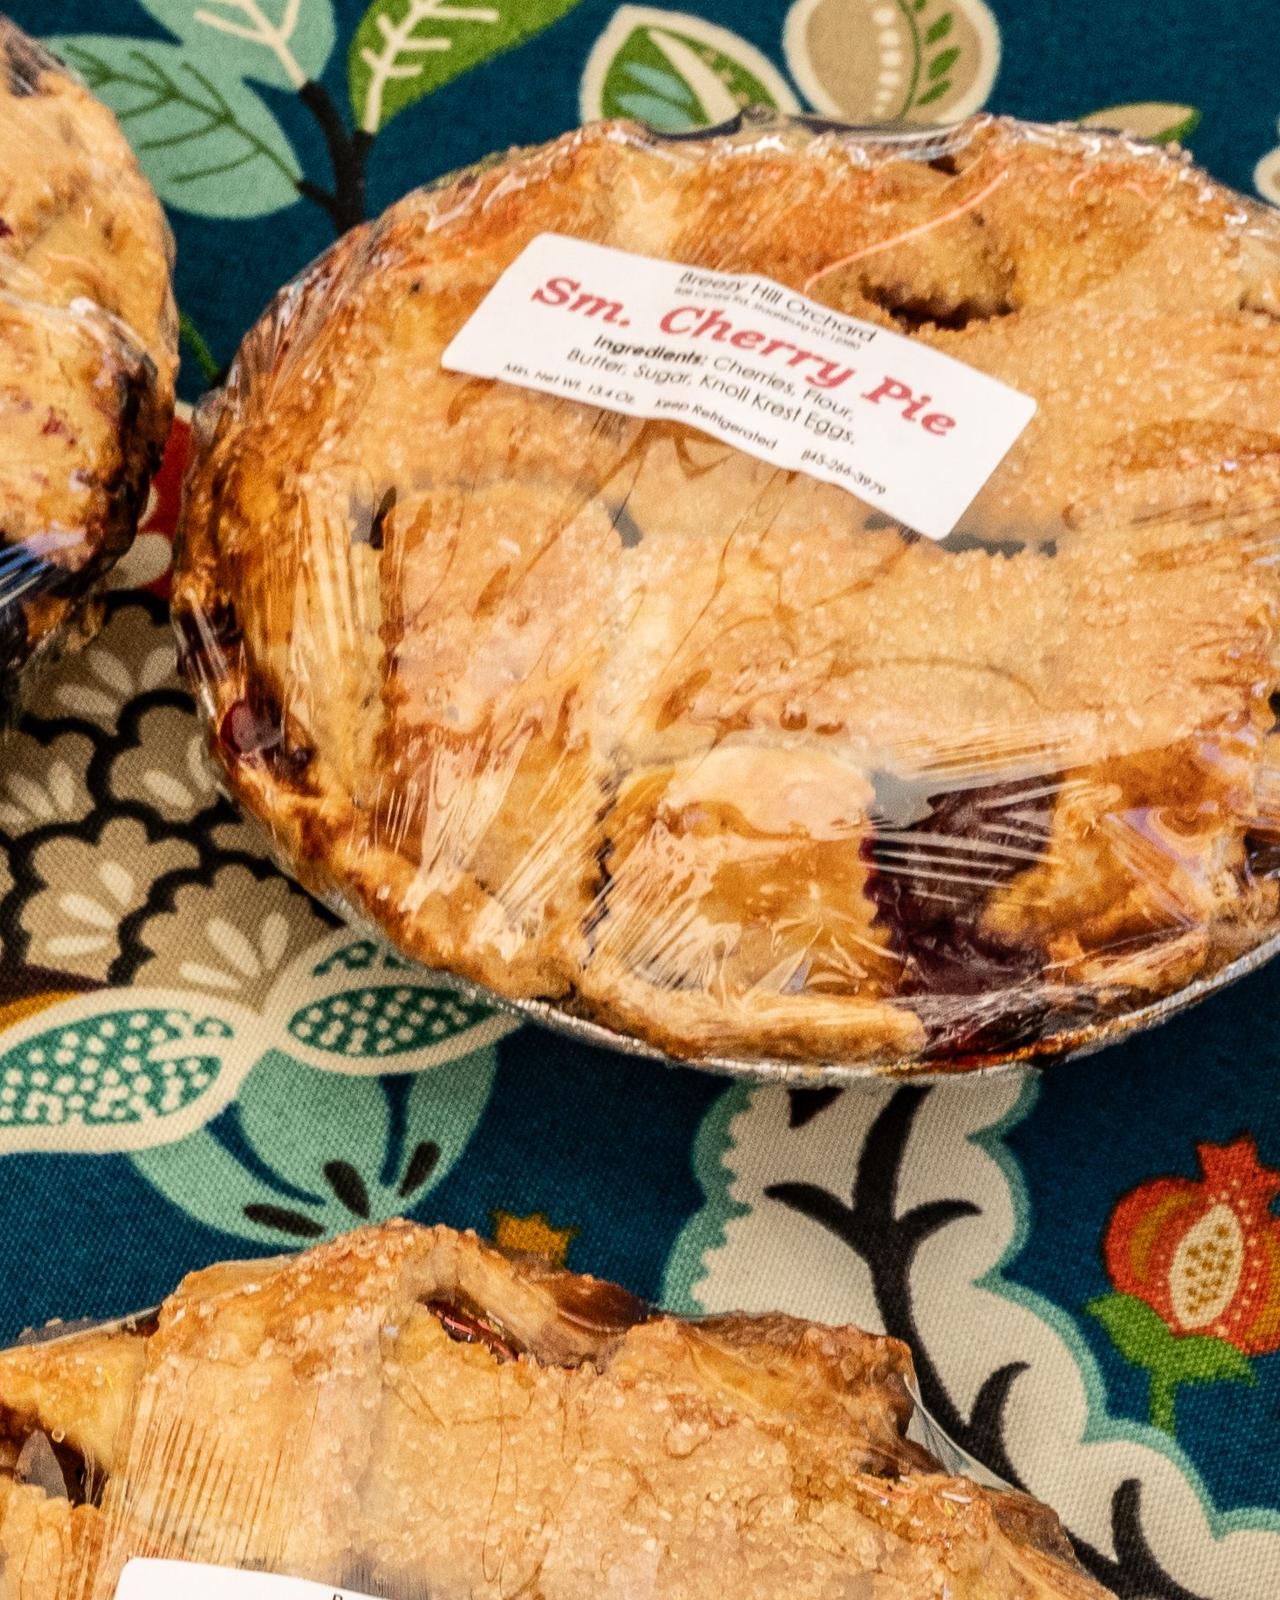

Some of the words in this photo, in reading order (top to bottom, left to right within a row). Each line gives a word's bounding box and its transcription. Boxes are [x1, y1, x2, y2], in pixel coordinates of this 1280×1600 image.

[679, 272, 747, 294] Breezy
[751, 282, 784, 305] Hill
[786, 298, 877, 343] Orchard
[531, 276, 630, 328] Sm.
[659, 305, 856, 389] Cherry
[861, 376, 957, 435] Pie
[594, 334, 707, 364] Ingredients:
[714, 357, 796, 396] Cherries,
[803, 384, 853, 421] Flour,
